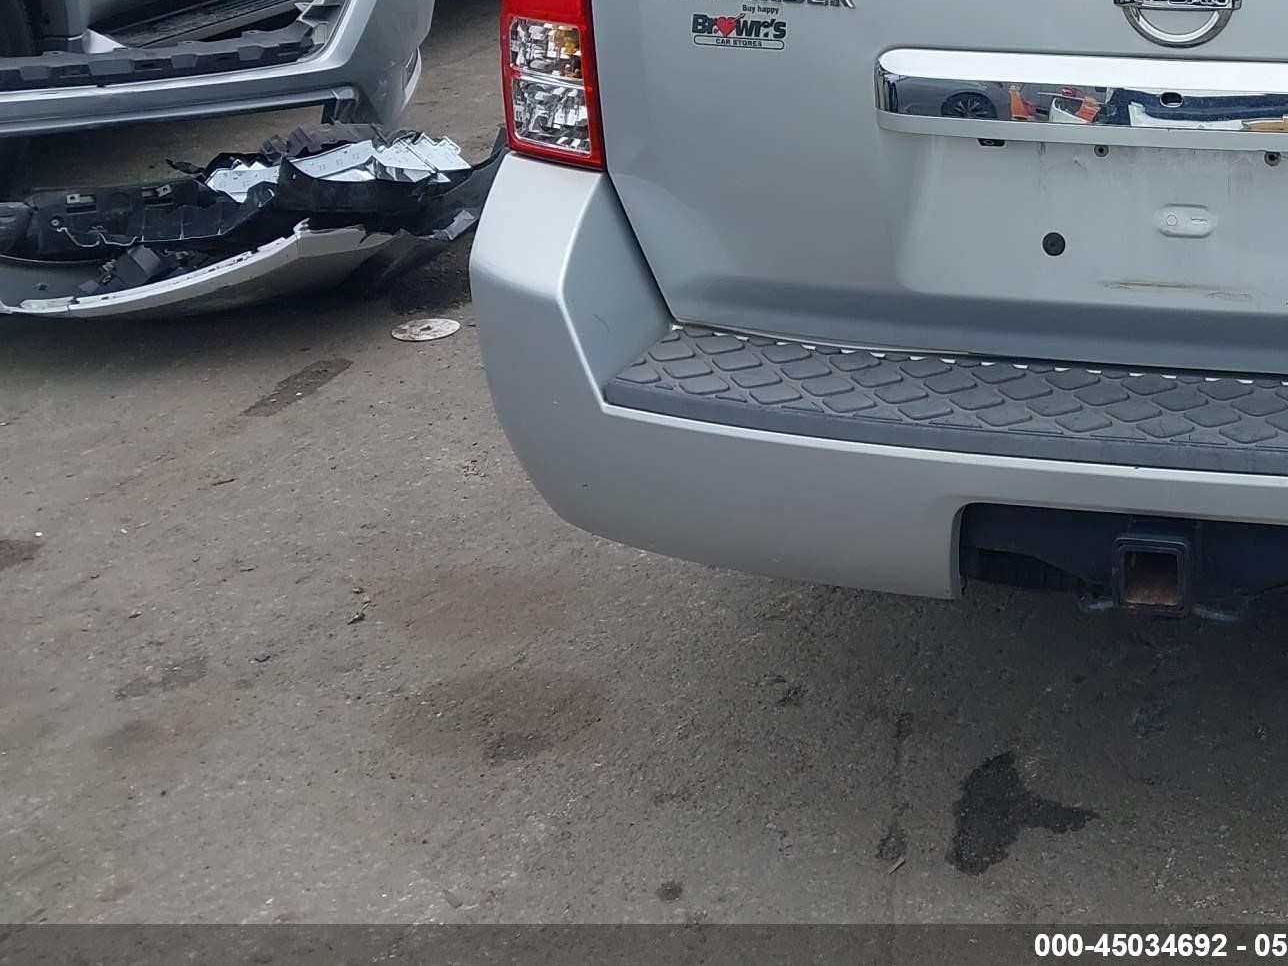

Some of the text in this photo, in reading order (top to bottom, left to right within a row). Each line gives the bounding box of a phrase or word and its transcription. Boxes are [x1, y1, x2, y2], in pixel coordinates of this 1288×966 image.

[742, 4, 780, 15] Buy happy
[732, 39, 763, 47] STORES
